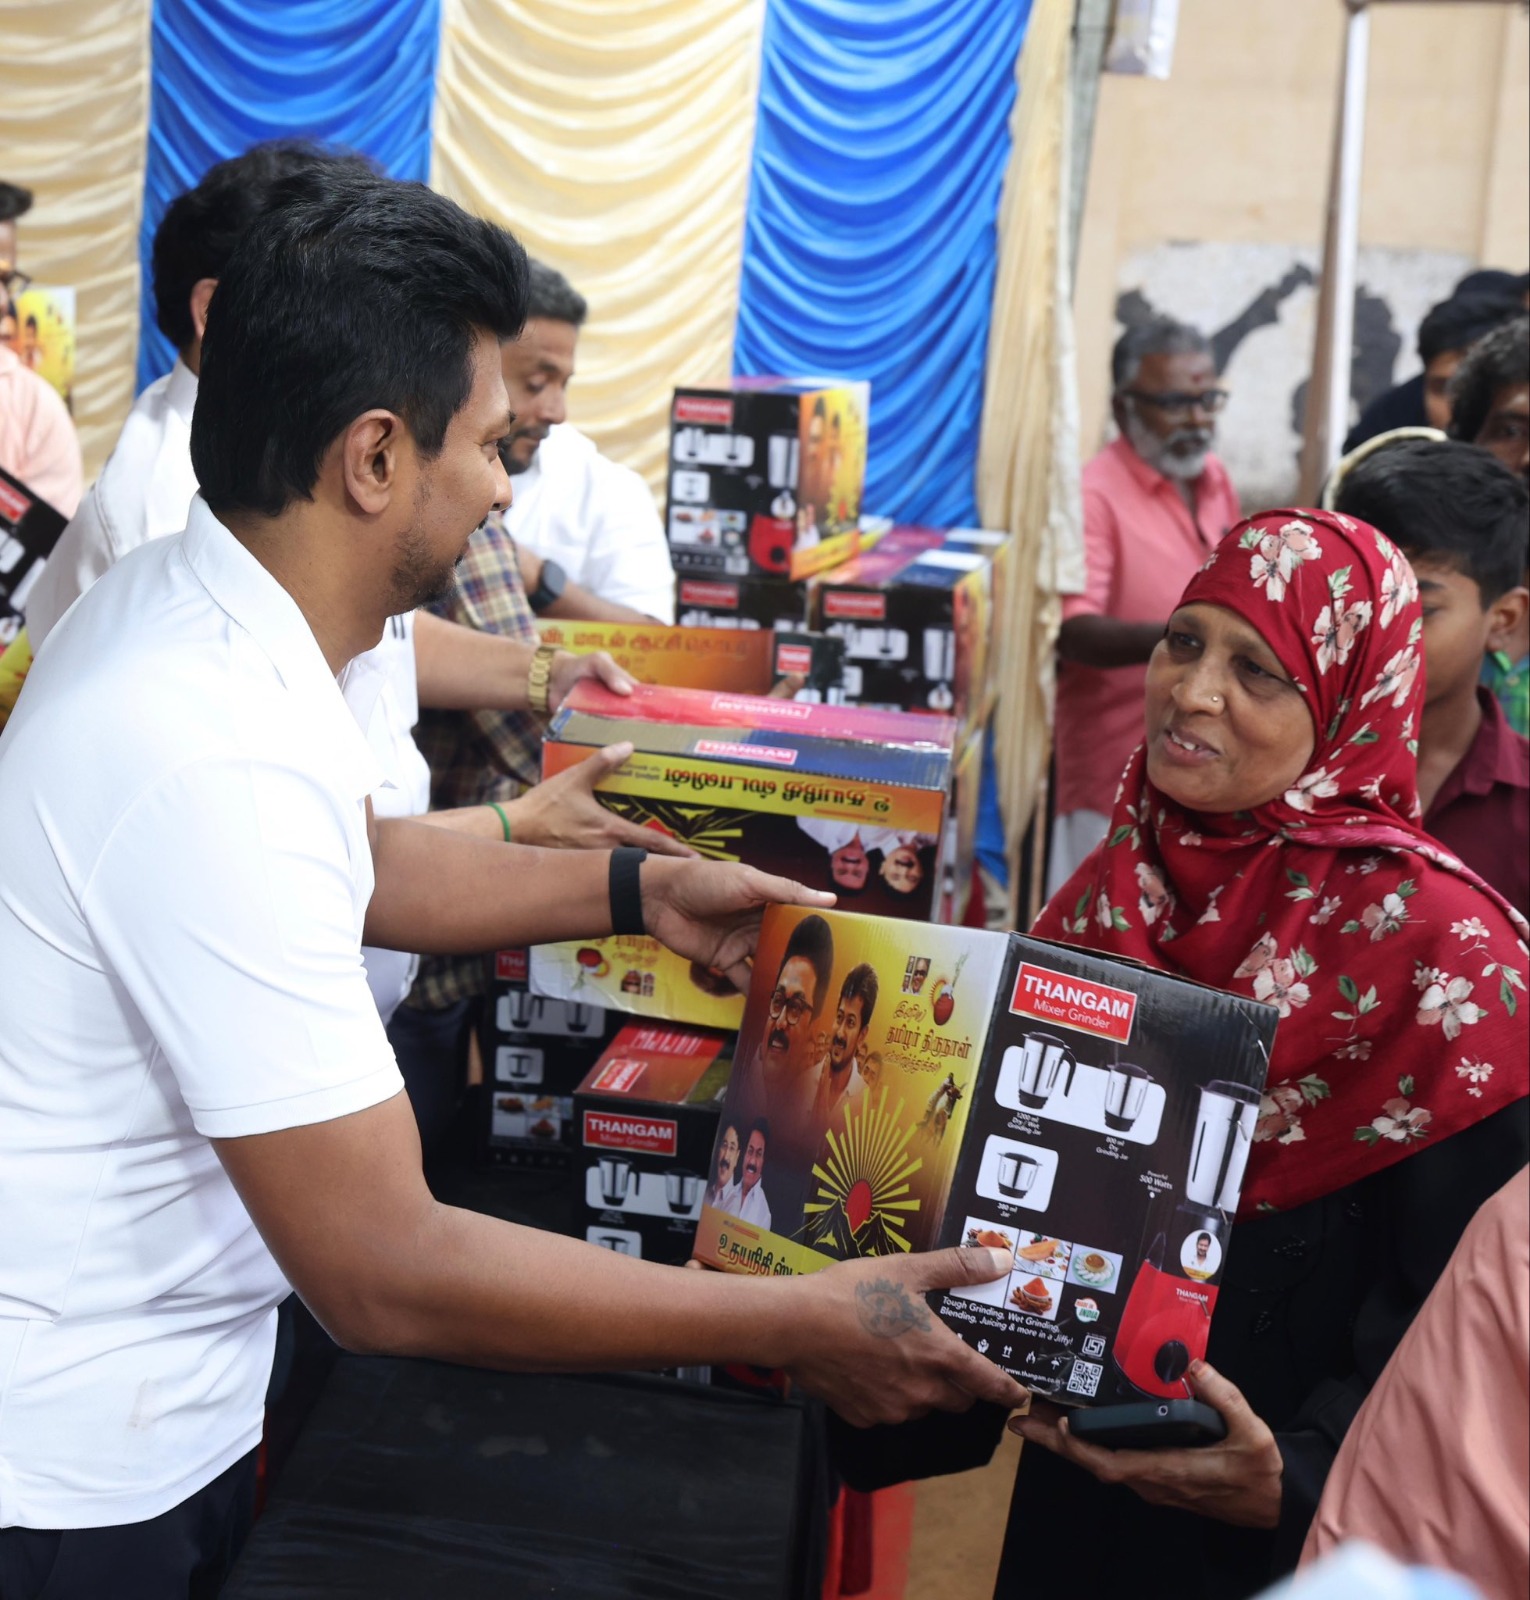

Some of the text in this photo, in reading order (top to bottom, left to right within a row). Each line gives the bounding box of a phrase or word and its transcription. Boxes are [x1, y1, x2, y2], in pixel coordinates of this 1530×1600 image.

[701, 742, 792, 758] THANGAM
[663, 767, 778, 795] ஸ்டாலின்
[1023, 973, 1130, 1020] THANGAM
[1033, 998, 1111, 1029] Mixer Grinder
[589, 1118, 673, 1140] THANGAM
[1154, 1177, 1173, 1190] Watts
[942, 1295, 968, 1310] Tough
[1008, 1312, 1025, 1324] Wet
[1079, 1308, 1099, 1320] INDIA
[940, 1306, 977, 1324] Blending,
[980, 1316, 1007, 1331] Juicing
[1008, 1323, 1016, 1331] &
[1017, 1326, 1038, 1338] more
[1038, 1329, 1047, 1338] in
[1054, 1333, 1074, 1346] Jiffy!
